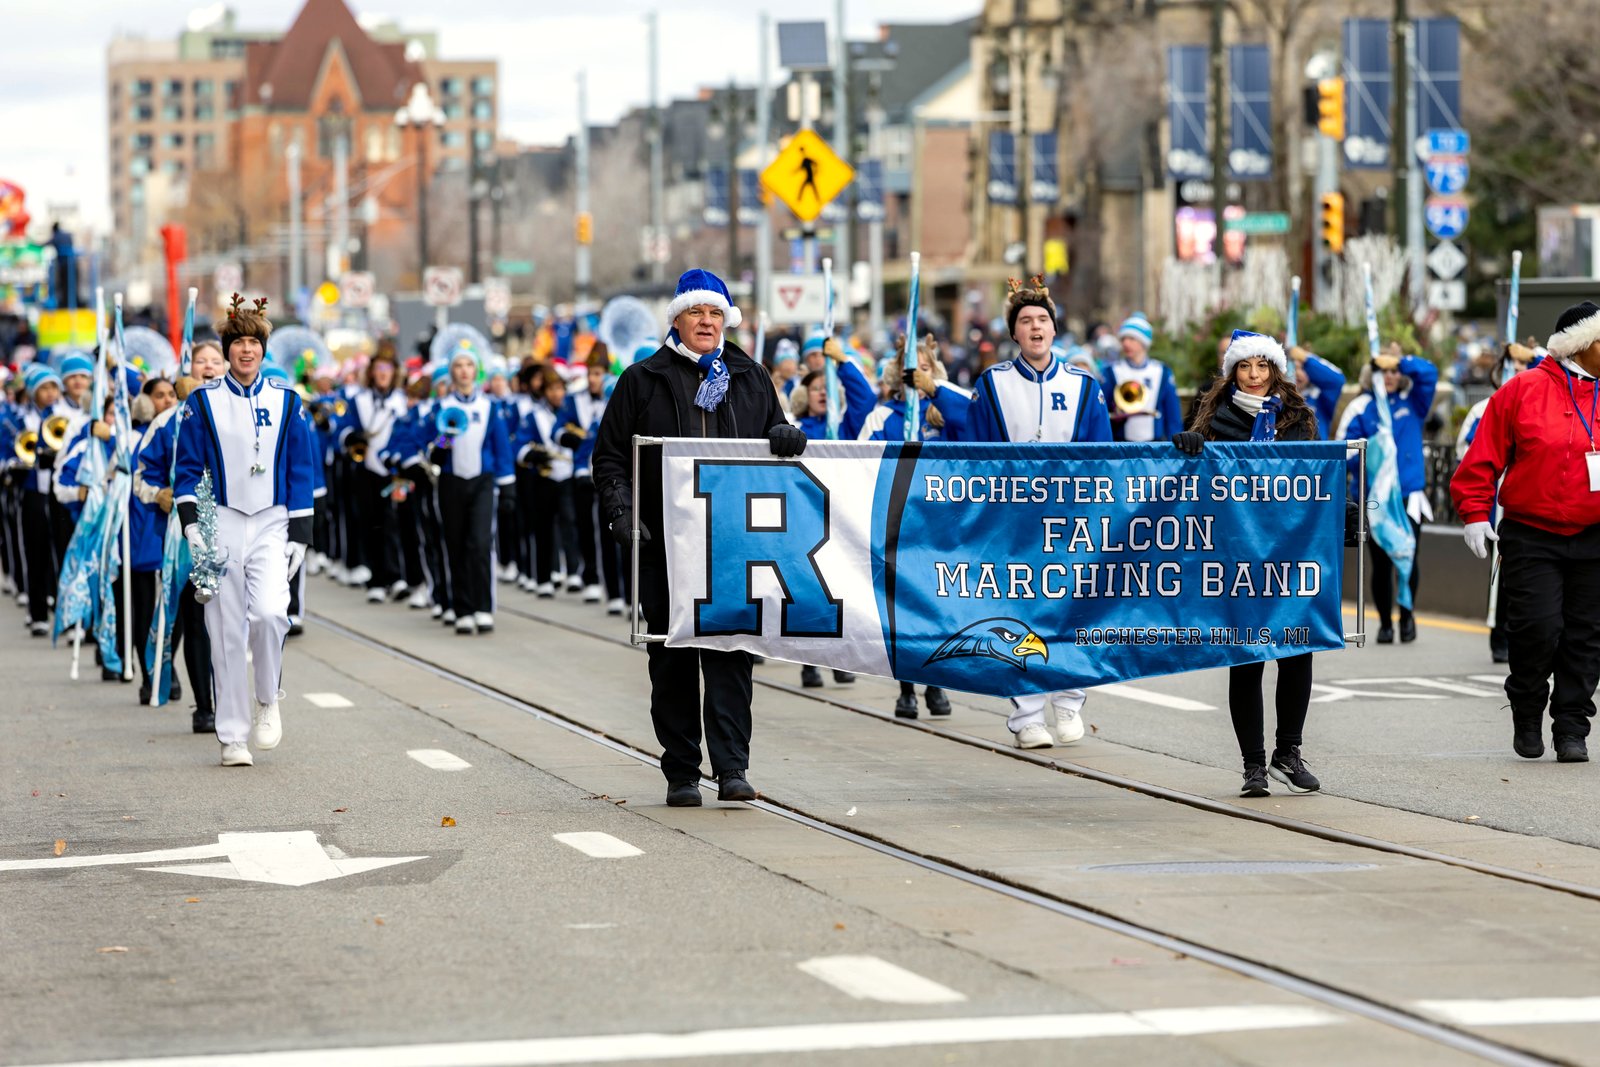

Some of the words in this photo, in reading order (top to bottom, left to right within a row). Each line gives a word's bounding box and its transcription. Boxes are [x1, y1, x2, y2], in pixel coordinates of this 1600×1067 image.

[1430, 163, 1465, 191] 75
[1051, 392, 1067, 410] R
[255, 408, 272, 426] R
[924, 475, 1116, 503] ROCHESTER
[1125, 475, 1200, 503] HIGH
[1210, 474, 1332, 502] SCHOOL
[1042, 515, 1215, 553] FALCON
[694, 459, 843, 638] R
[935, 561, 1183, 599] MARCHING
[1201, 561, 1322, 597] BAND
[1075, 627, 1202, 646] ROCHESTER
[1283, 627, 1310, 645] MI
